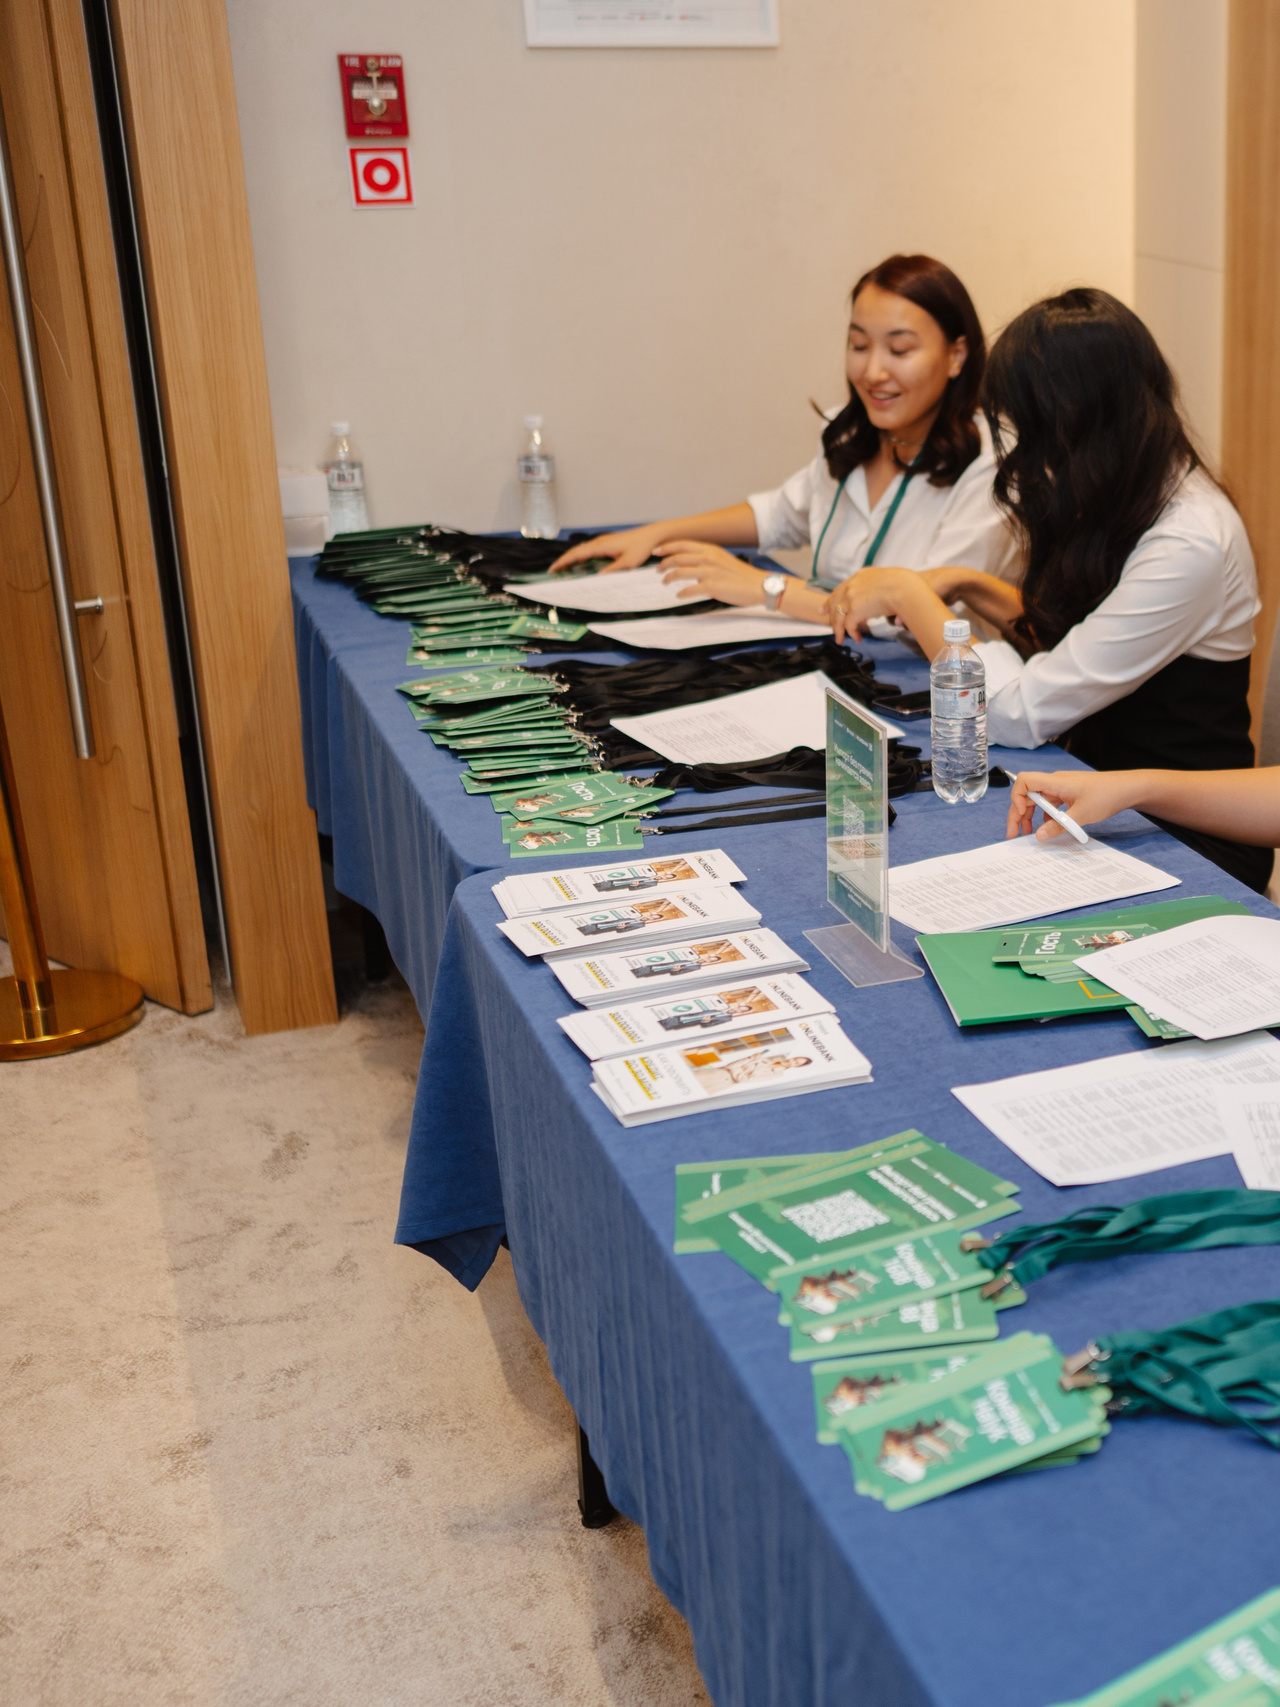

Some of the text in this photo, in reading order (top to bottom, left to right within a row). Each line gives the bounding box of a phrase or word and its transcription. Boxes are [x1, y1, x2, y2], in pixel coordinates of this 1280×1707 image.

[567, 781, 595, 801] Гость
[694, 855, 720, 880] ONLINEBANK
[677, 894, 710, 918] ONLINEBANK
[739, 935, 769, 961] ONLINEBANK
[1035, 932, 1062, 954] Гость
[767, 982, 803, 1011] ONLINEBANK
[799, 1022, 836, 1063] ONLINEBANK
